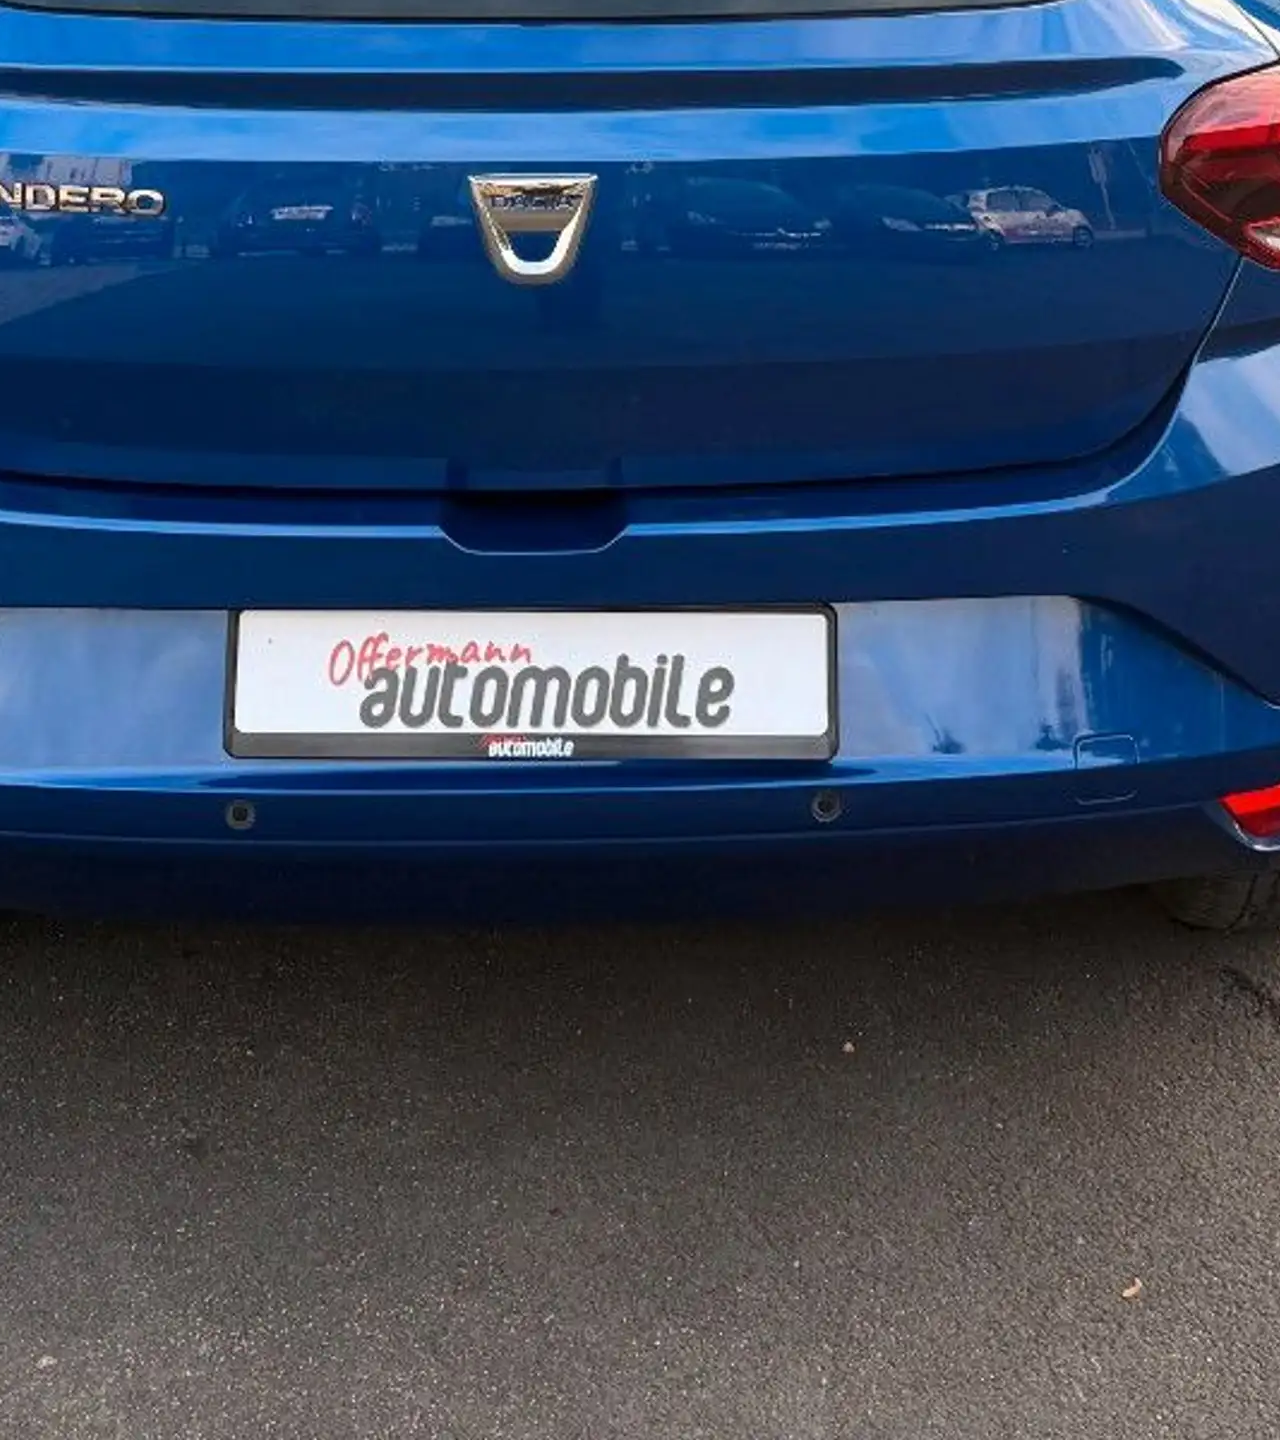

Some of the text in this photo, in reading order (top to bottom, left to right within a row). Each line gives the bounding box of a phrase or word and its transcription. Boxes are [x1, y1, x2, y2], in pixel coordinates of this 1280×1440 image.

[328, 632, 532, 687] Offermann
[358, 654, 736, 729] automobile
[487, 737, 575, 758] automobile
